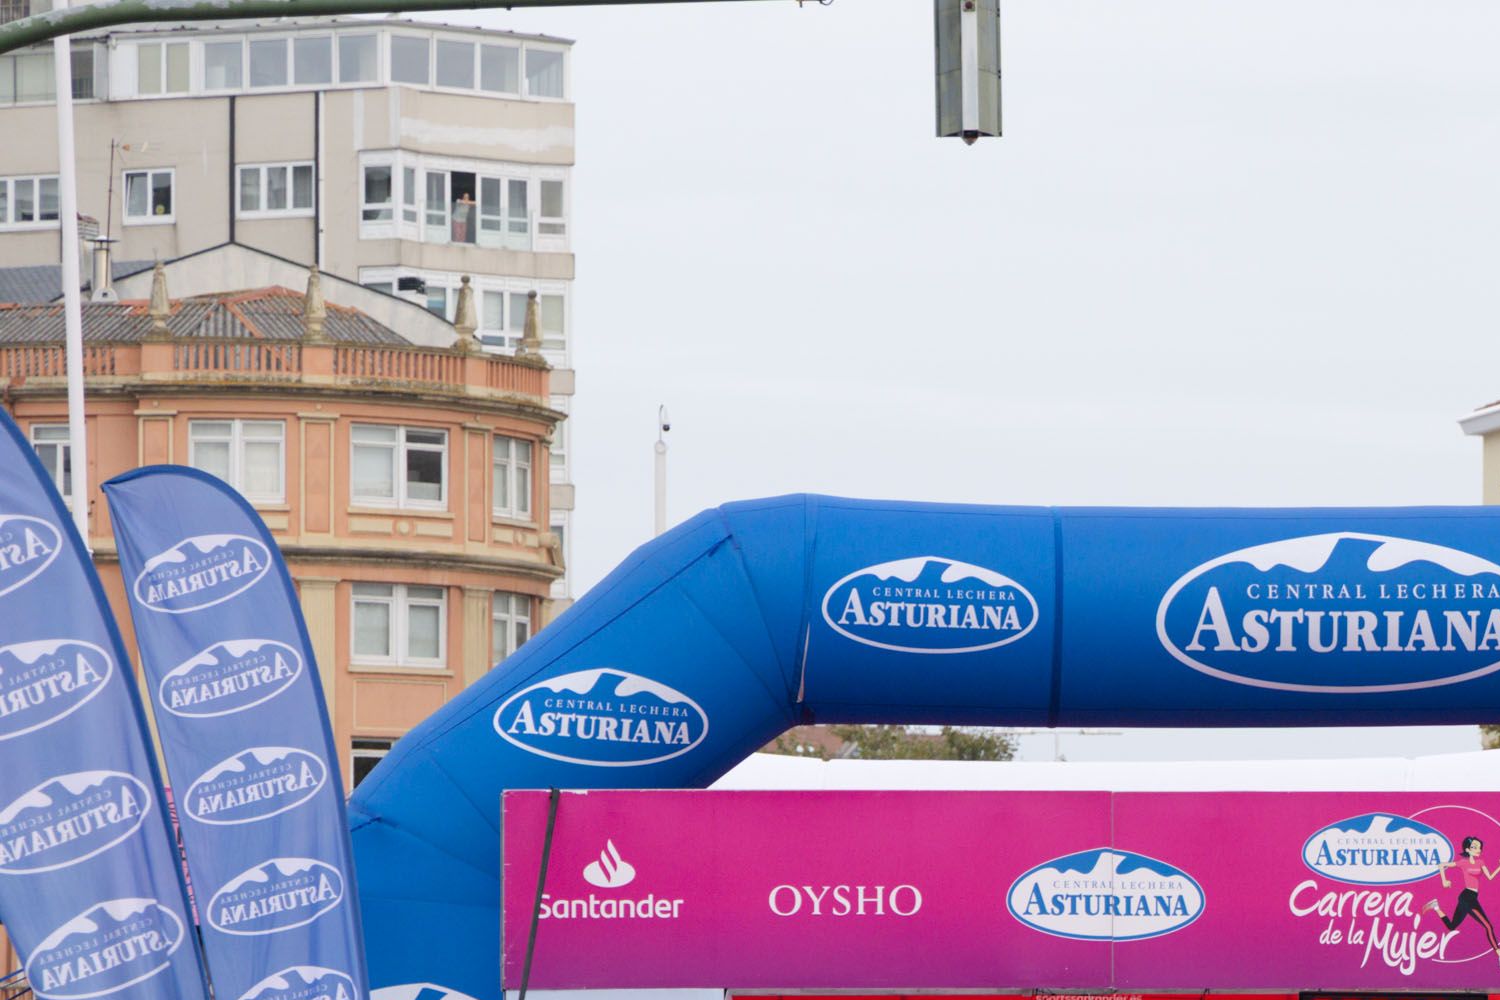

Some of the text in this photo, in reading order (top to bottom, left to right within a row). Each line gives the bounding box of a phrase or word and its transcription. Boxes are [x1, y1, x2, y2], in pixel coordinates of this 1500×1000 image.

[872, 587, 1016, 601] CENTRAL LECHERA
[1247, 583, 1500, 600] CENTRAL LECHERA
[837, 587, 1023, 631] ASTURIANA
[544, 698, 689, 717] CENTRAL LECHERA
[507, 700, 691, 745] ASTURIANA
[1314, 839, 1442, 867] ASTURIANA
[1337, 837, 1438, 846] CENTRAL LECHERA
[1022, 882, 1191, 917] ASTURIANA
[1052, 880, 1184, 891] CENTRAL LECHERA
[1288, 879, 1414, 918] Carrera
[538, 893, 685, 920] Santander
[768, 884, 923, 917] OYSHO
[1319, 913, 1461, 977] de la Mujer
